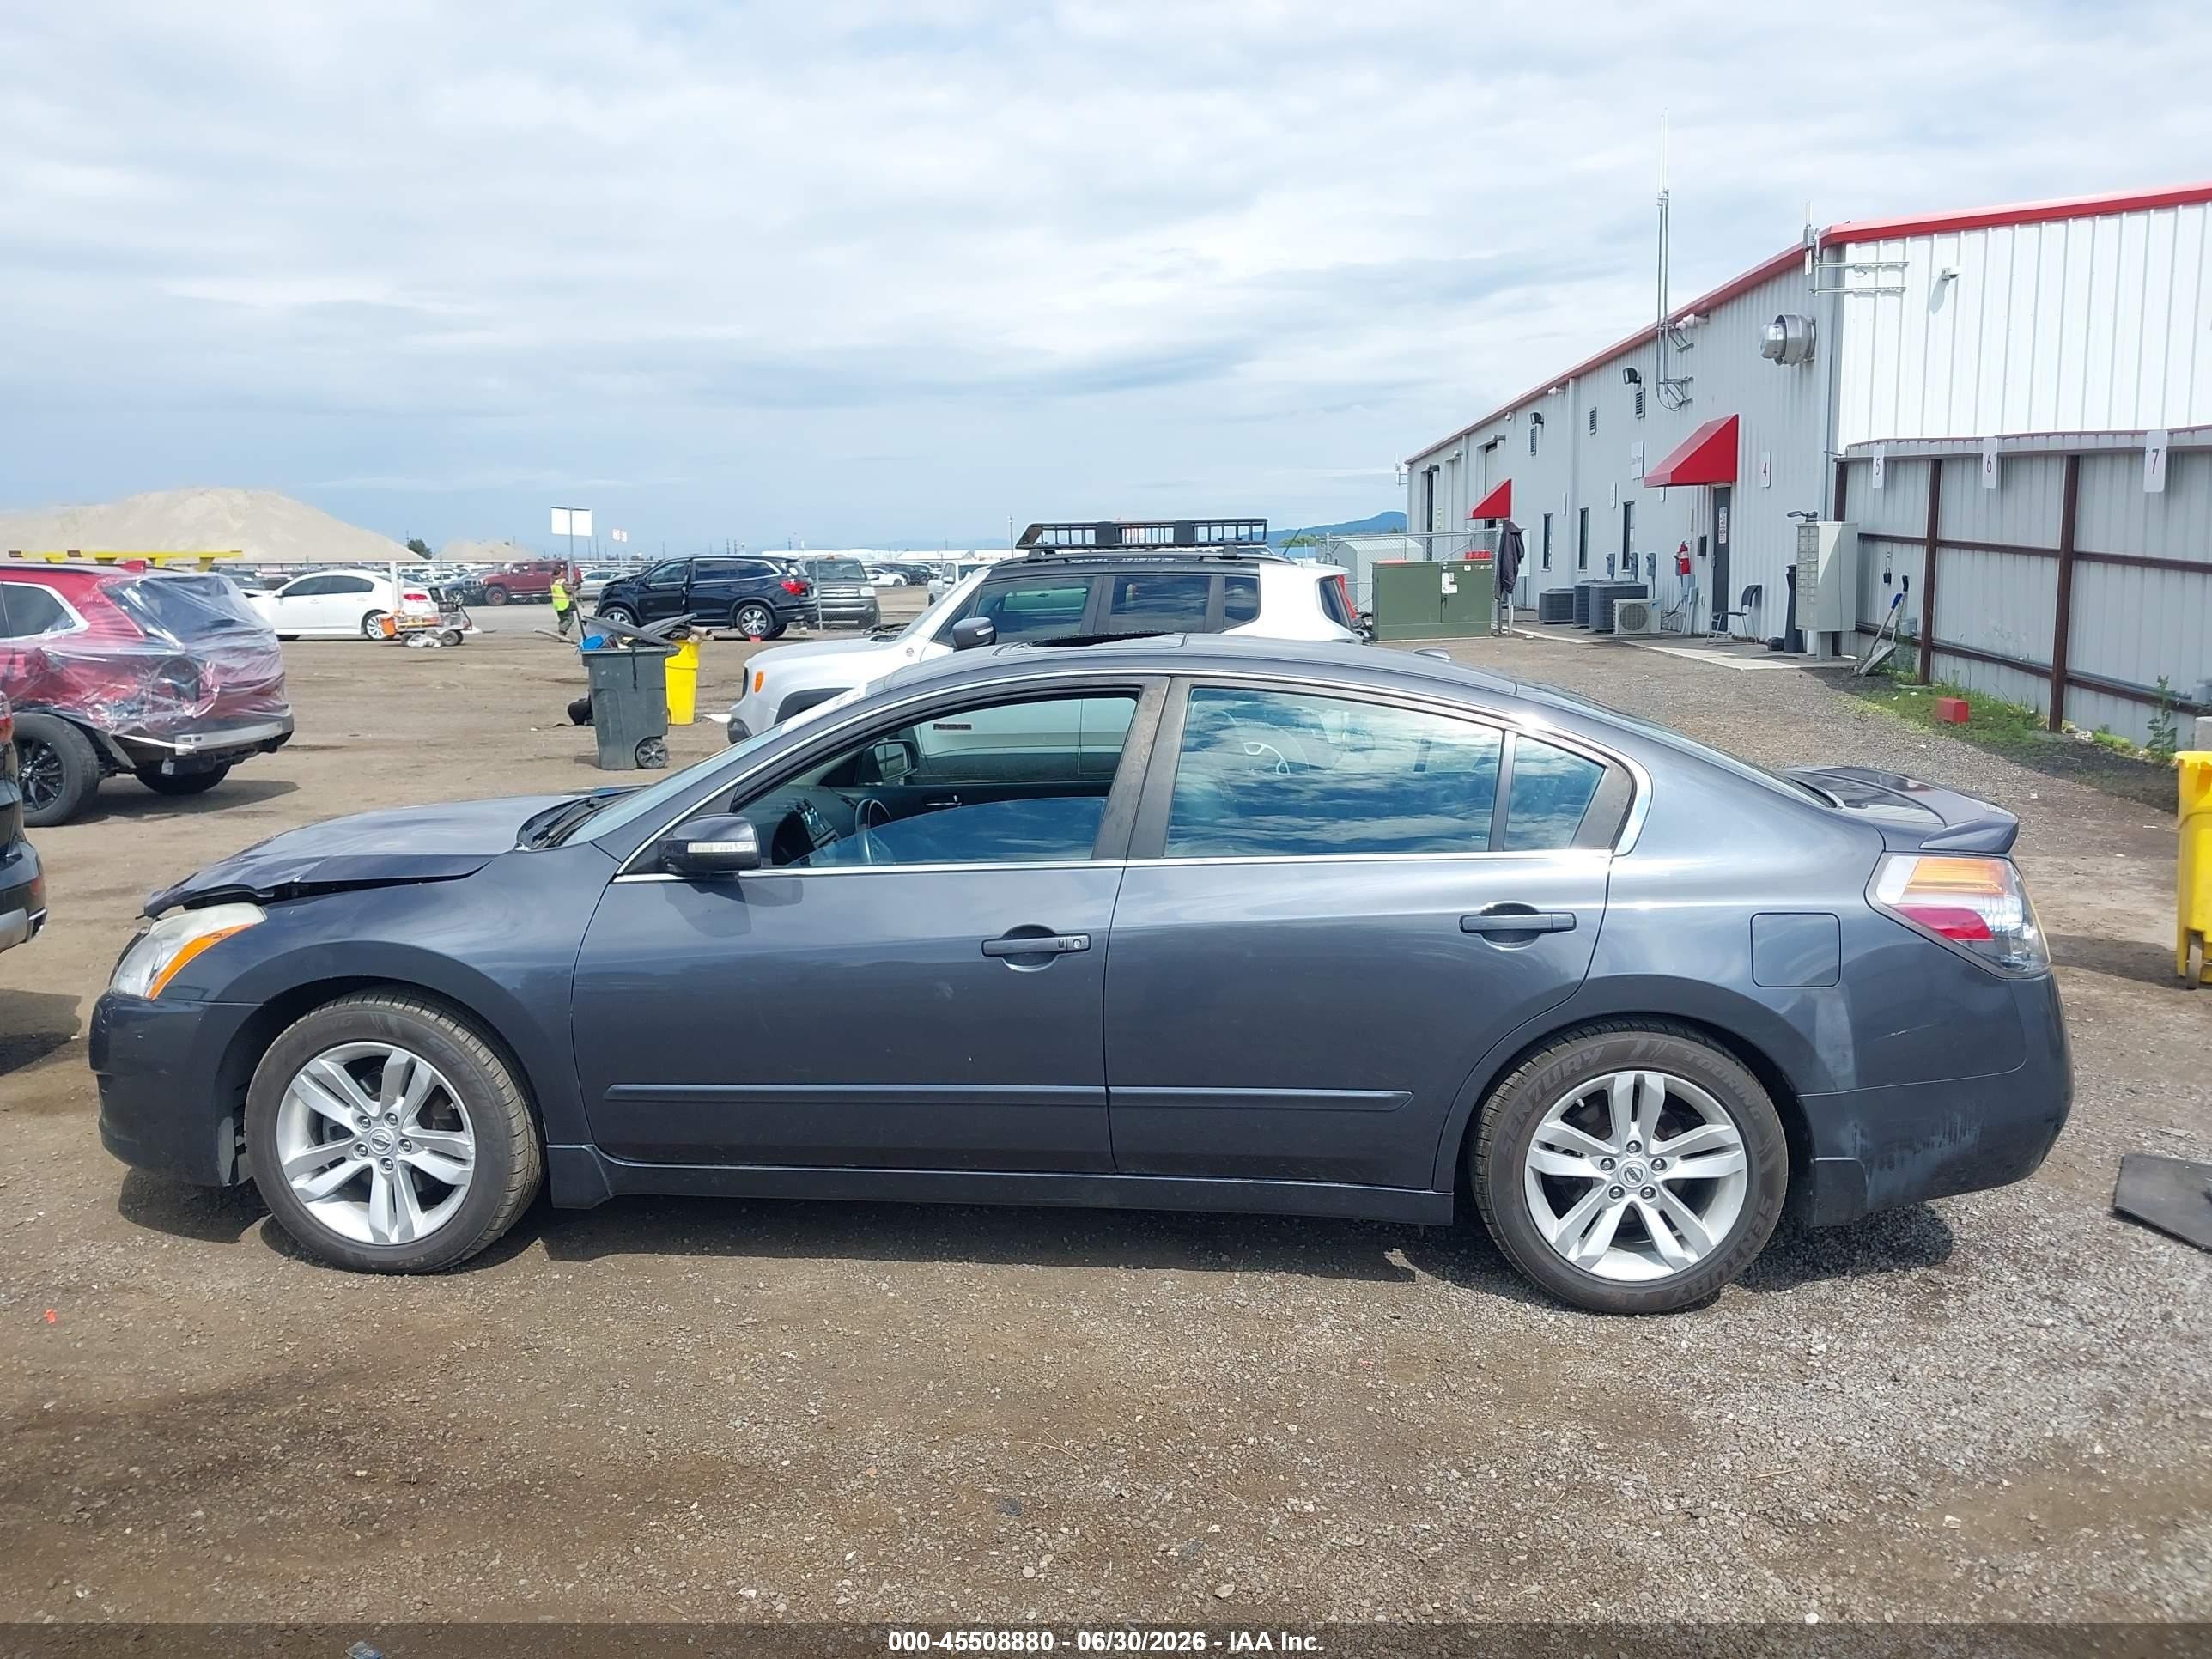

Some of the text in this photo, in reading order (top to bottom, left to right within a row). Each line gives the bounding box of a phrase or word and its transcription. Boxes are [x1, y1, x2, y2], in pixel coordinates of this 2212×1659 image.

[1875, 457, 1881, 476] 5
[1986, 453, 1992, 473] 6
[2152, 448, 2160, 474] 7
[1685, 1050, 1762, 1120] TOURING
[1498, 1045, 1605, 1155] SENTURY
